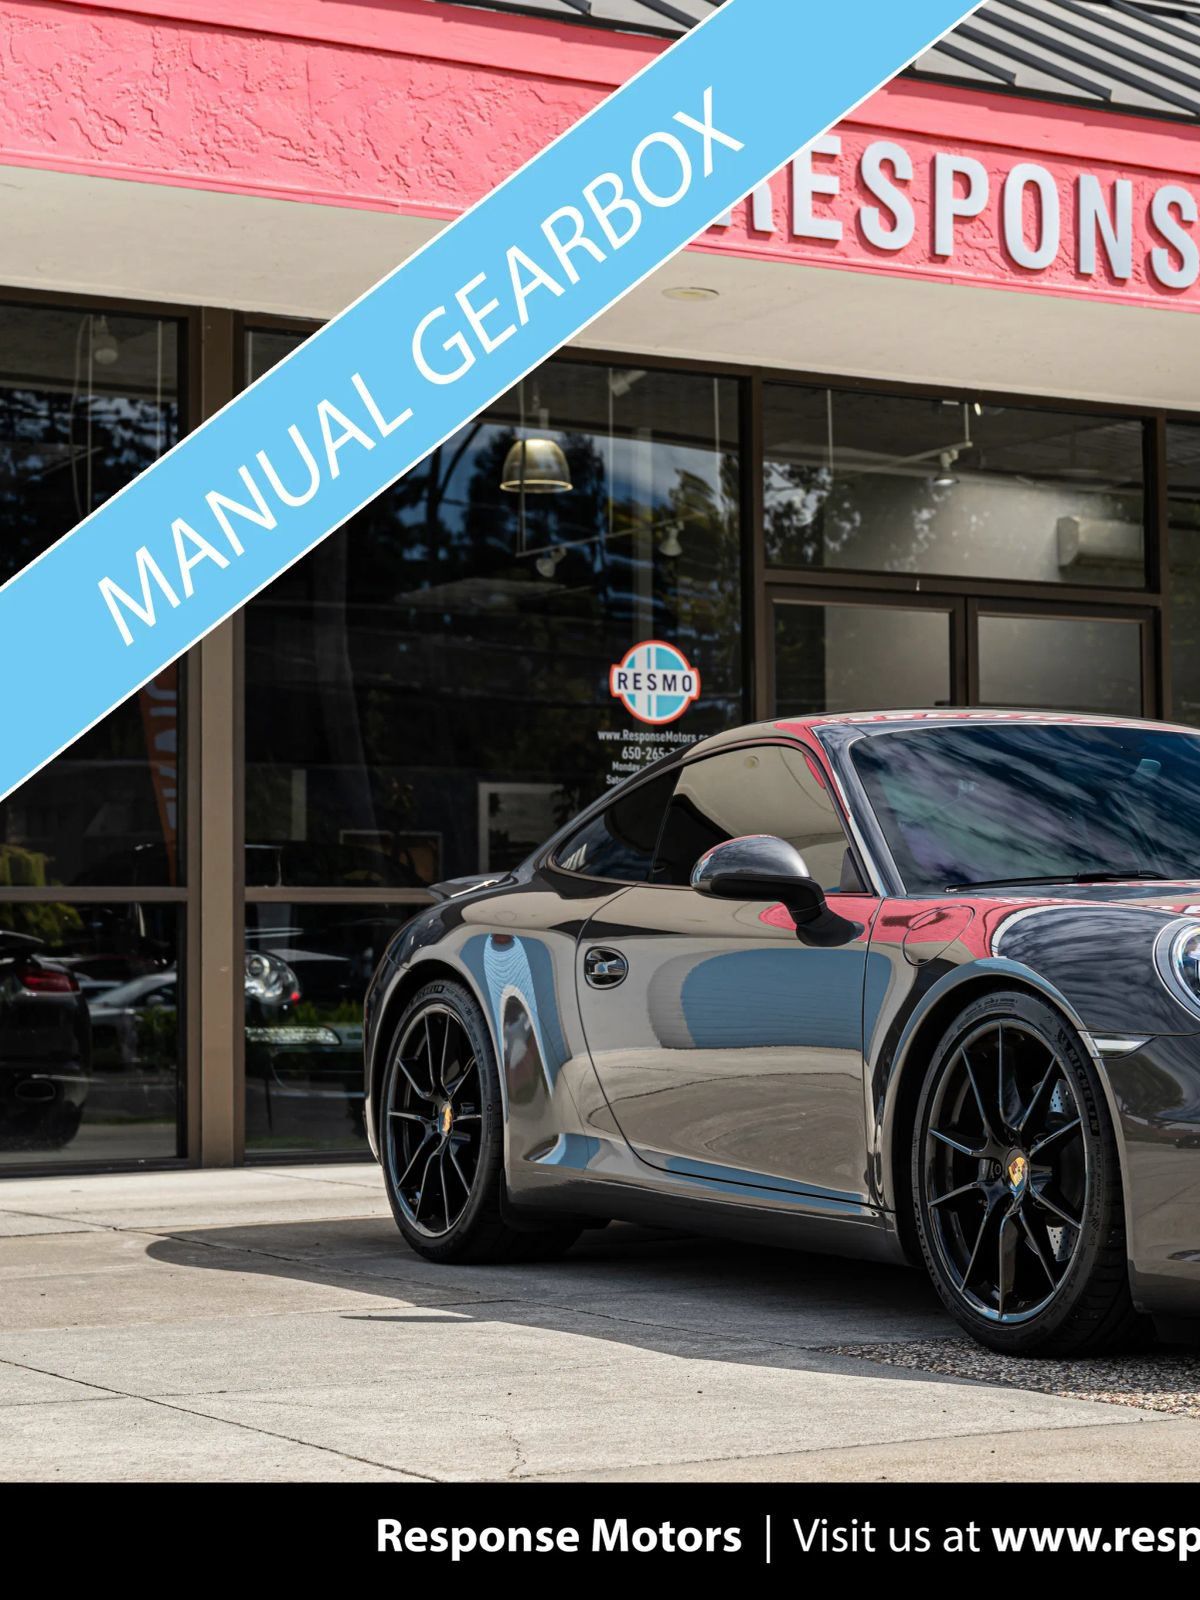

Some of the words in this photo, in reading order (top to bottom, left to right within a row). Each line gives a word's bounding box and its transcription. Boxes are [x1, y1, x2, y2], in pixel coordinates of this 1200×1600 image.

[617, 672, 692, 692] RESMO
[622, 746, 677, 760] 650-265-
[1066, 1048, 1100, 1132] MICHELIN
